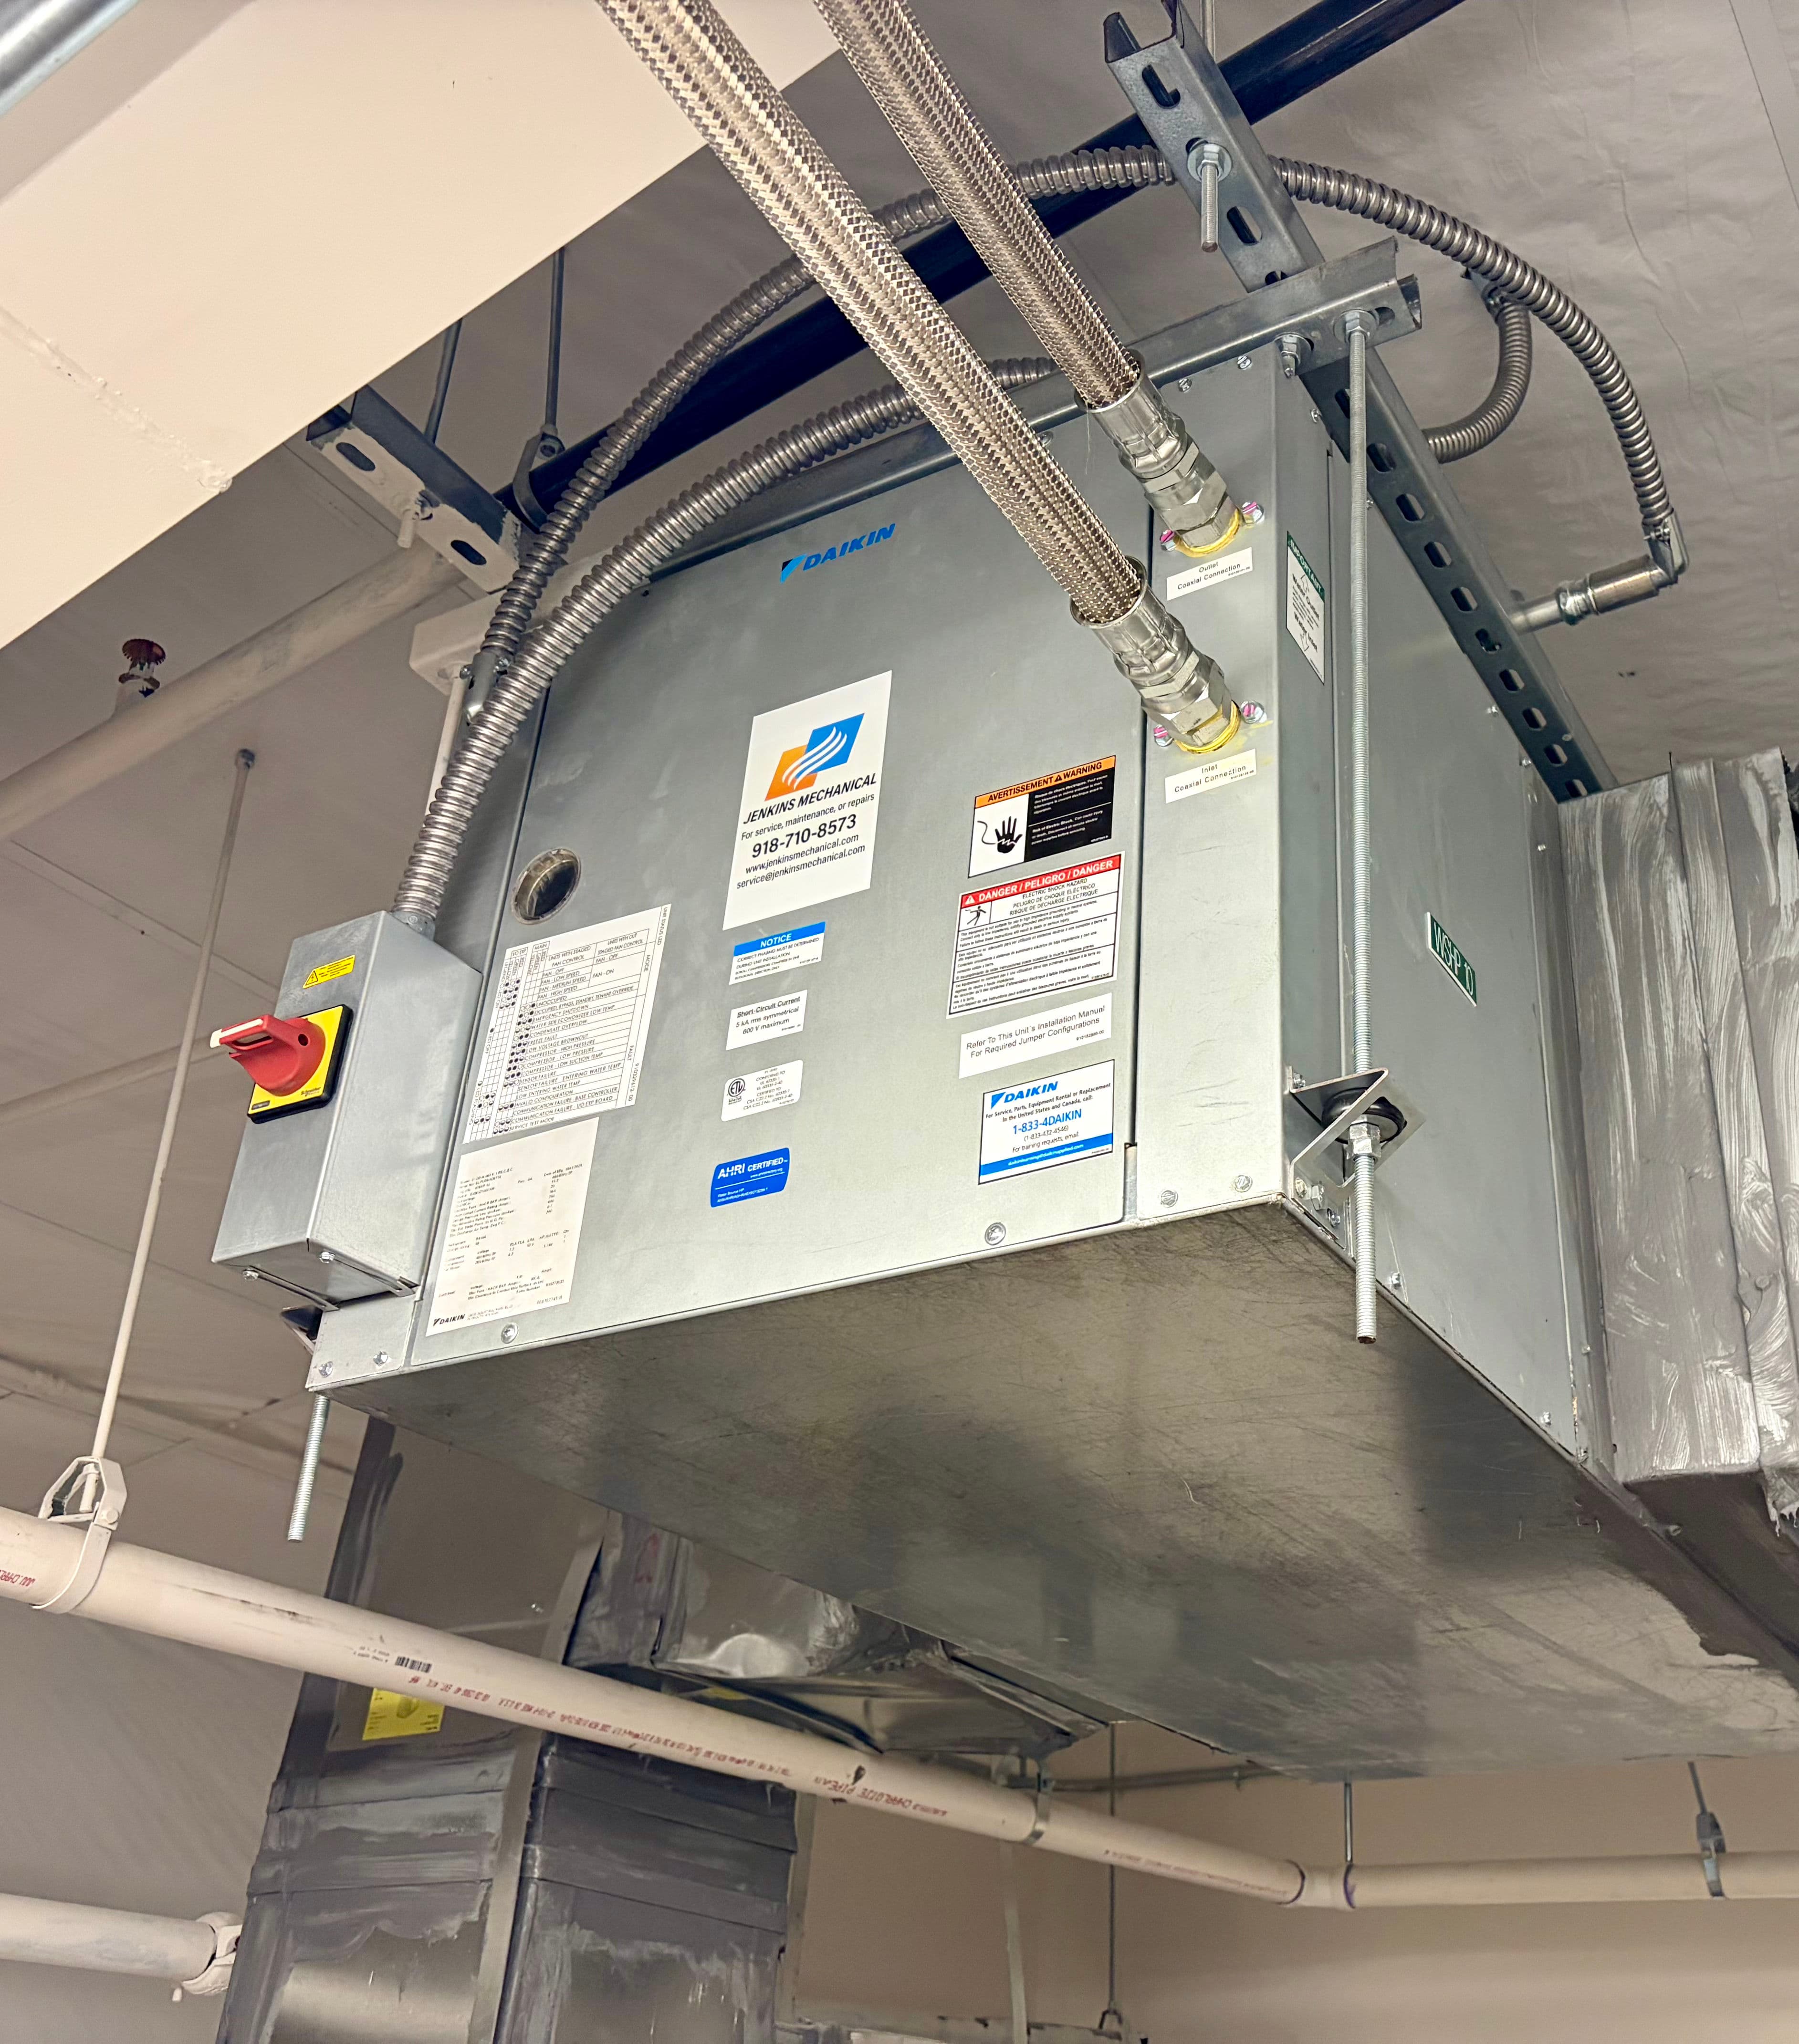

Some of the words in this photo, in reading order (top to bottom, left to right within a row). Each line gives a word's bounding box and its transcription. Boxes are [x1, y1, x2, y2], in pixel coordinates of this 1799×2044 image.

[803, 523, 896, 571] DAIKIN
[1178, 576, 1202, 590] Coaxial
[1204, 564, 1240, 580] Connection
[1199, 562, 1218, 573] Outlet
[1290, 540, 1321, 593] IMPORTANT
[1175, 779, 1202, 793] Coaxial
[1204, 766, 1246, 782] Connection
[1202, 764, 1217, 773] Inlet
[988, 776, 1053, 802] AVERTISSEMENT
[1063, 762, 1102, 779] WARNING
[743, 798, 796, 824] JENKINS
[797, 773, 876, 808] MECHANICAL
[741, 831, 753, 841] For
[755, 823, 784, 836] service,
[785, 806, 836, 827] maintenance,
[838, 803, 847, 811] or
[847, 794, 874, 808] repairs
[752, 814, 856, 858] 918-710-8573
[737, 845, 865, 889] service@jenkinsmechanical.com
[746, 834, 859, 874] www.jenkinsmechanical.com
[979, 885, 1017, 902] DANGER
[1025, 873, 1065, 889] PELIGRO
[1073, 860, 1113, 877] DANGER
[1022, 888, 1046, 899] ELECTRIC
[1067, 878, 1087, 887] HAZARD
[761, 933, 792, 948] NOTICE
[562, 955, 584, 964] CONTROL
[1433, 921, 1461, 976] WSHP
[1464, 962, 1473, 996] 10
[763, 1006, 799, 1021] symmetrical
[777, 996, 800, 1007] Current
[761, 1019, 789, 1029] maximum
[966, 1040, 986, 1050] Refer
[998, 1032, 1013, 1041] This
[1038, 1015, 1076, 1030] Installation
[1078, 1005, 1105, 1018] Manual
[971, 1050, 983, 1058] For
[985, 1039, 1016, 1054] Required
[1019, 1033, 1045, 1045] Jumper
[1047, 1018, 1099, 1036] Configurations
[1004, 1081, 1058, 1103] DAIKIN
[1028, 1097, 1055, 1108] Equipment
[1056, 1092, 1071, 1101] Rental
[1079, 1083, 1111, 1095] Replacement
[1013, 1108, 1081, 1134] 1-833-4DAIKIN
[1018, 1110, 1034, 1118] United
[1062, 1098, 1081, 1107] Canada,
[1022, 1142, 1040, 1151] training
[718, 1163, 745, 1179] AHRI
[747, 1158, 784, 1172] CERTIFIED
[439, 1314, 465, 1324] DAIKIN
